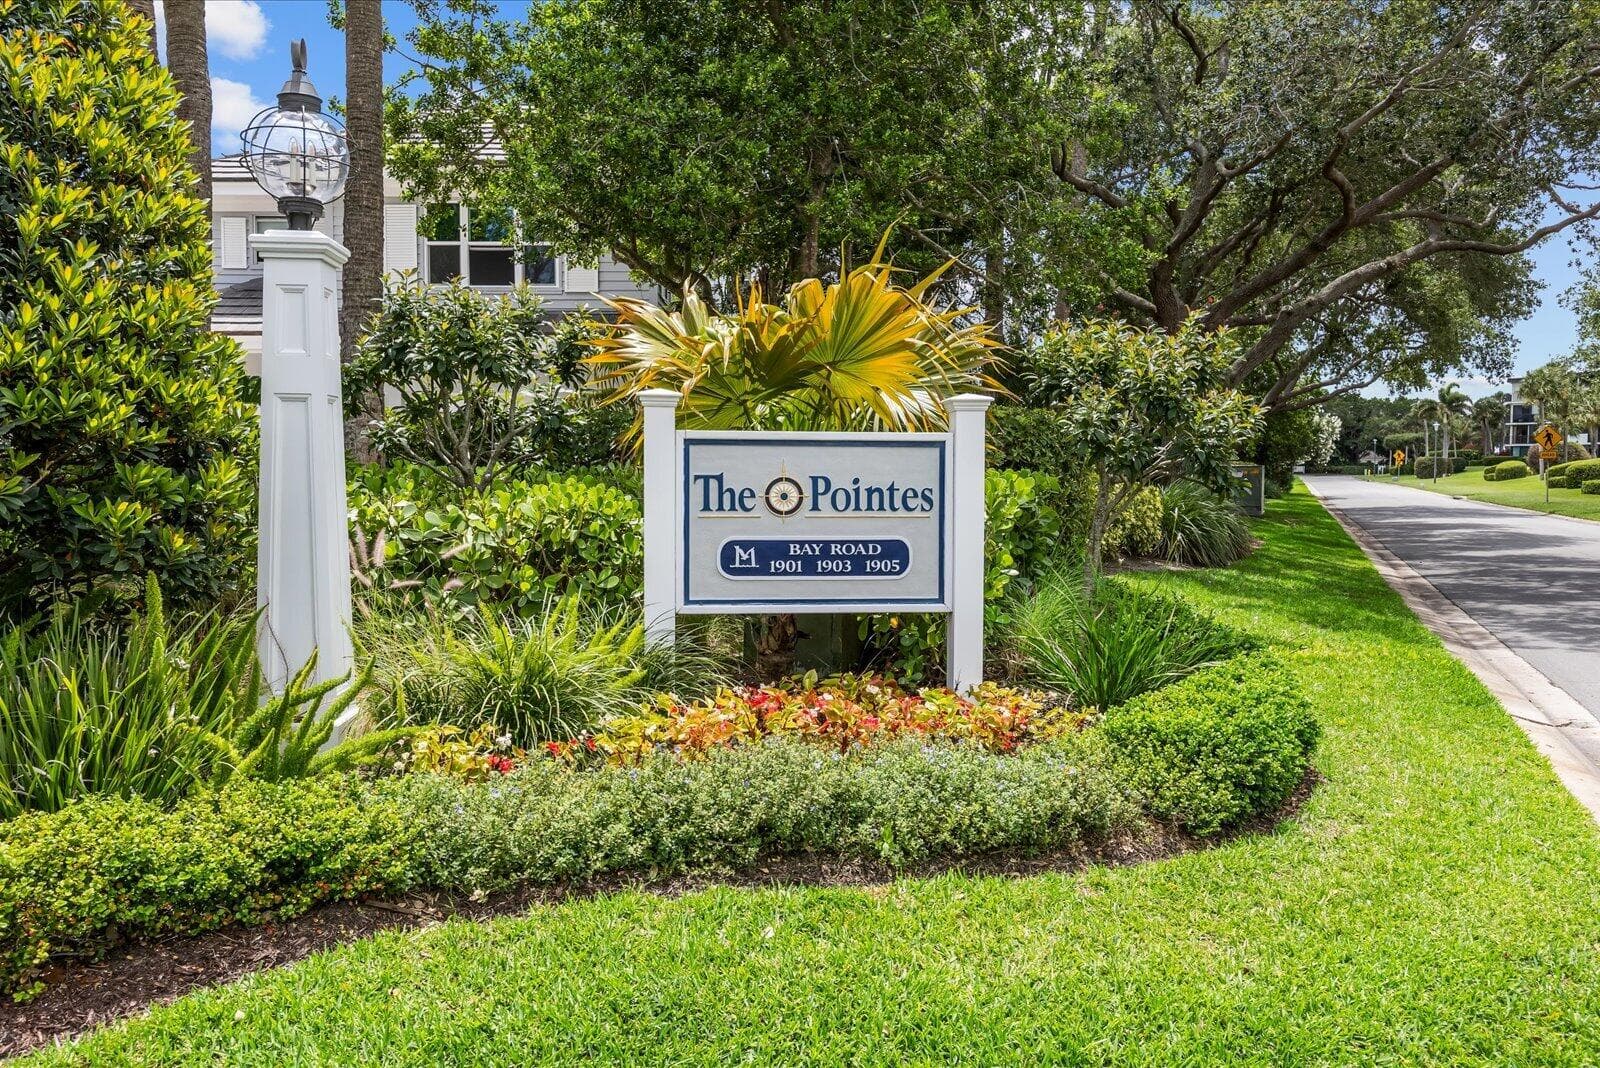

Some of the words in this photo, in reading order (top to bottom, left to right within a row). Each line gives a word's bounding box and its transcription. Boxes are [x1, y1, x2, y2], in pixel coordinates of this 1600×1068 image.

[693, 472, 757, 513] The
[808, 475, 935, 513] Pointes
[789, 543, 823, 556] BAY
[830, 543, 882, 556] ROAD
[769, 560, 802, 573] 1901
[816, 560, 852, 573] 1903
[865, 560, 901, 573] 1905
